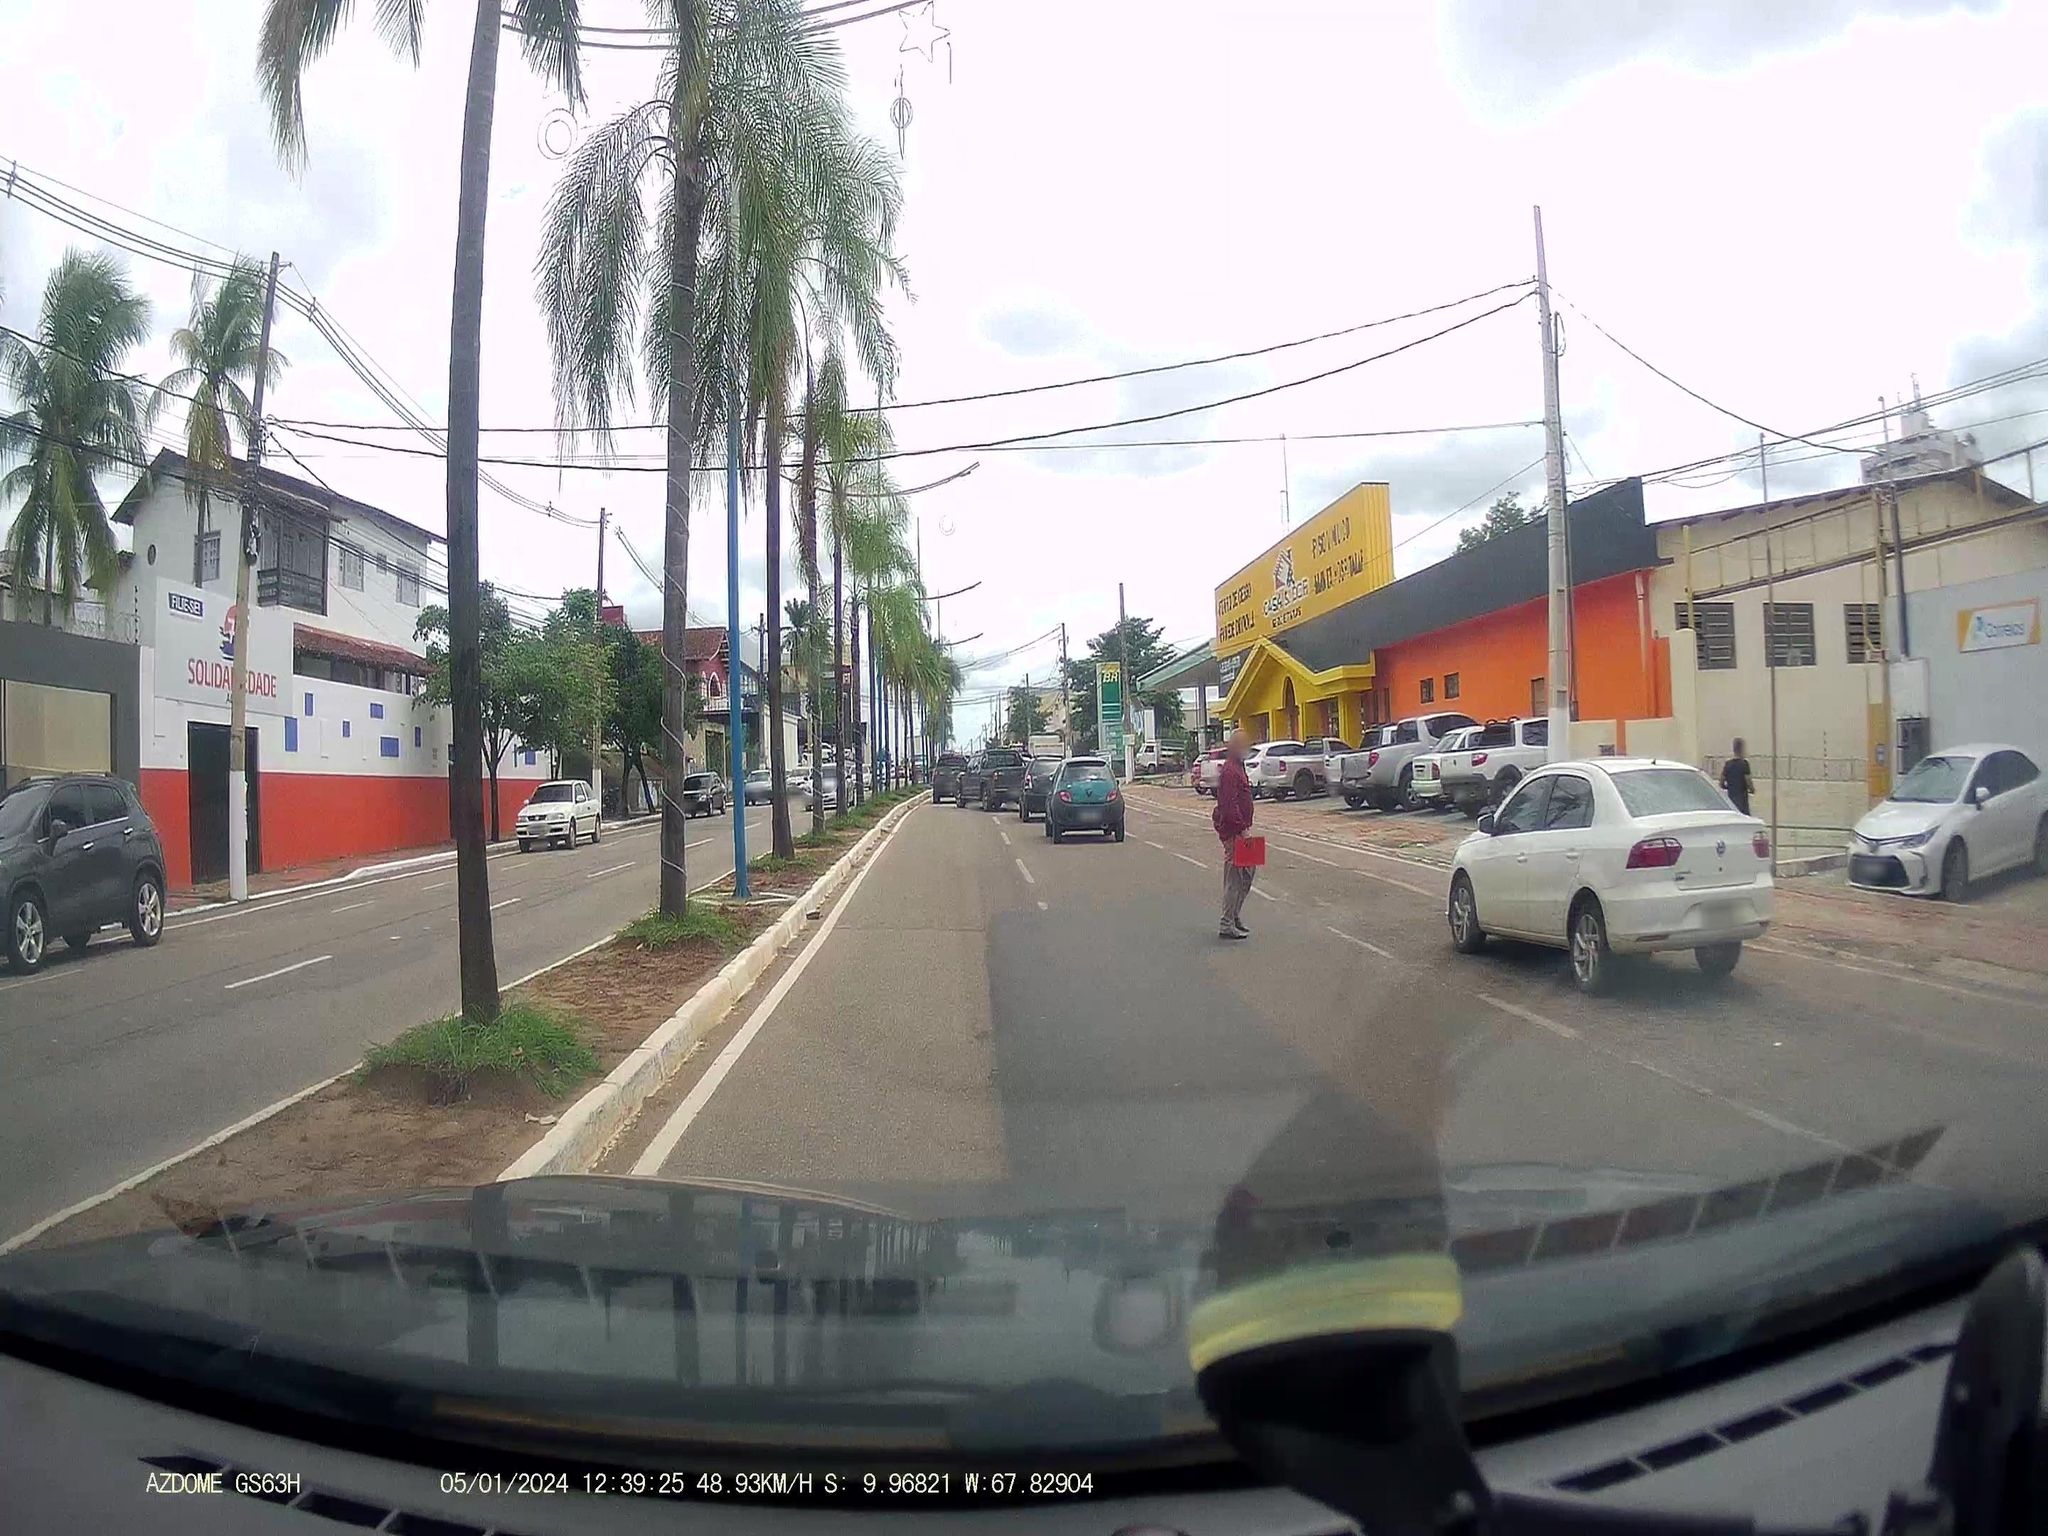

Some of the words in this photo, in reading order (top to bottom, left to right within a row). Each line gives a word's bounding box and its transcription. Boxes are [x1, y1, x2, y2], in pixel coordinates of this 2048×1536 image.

[1986, 623, 2025, 638] Correios
[188, 658, 277, 698] SOLIDADADE
[1102, 670, 1119, 683] BR
